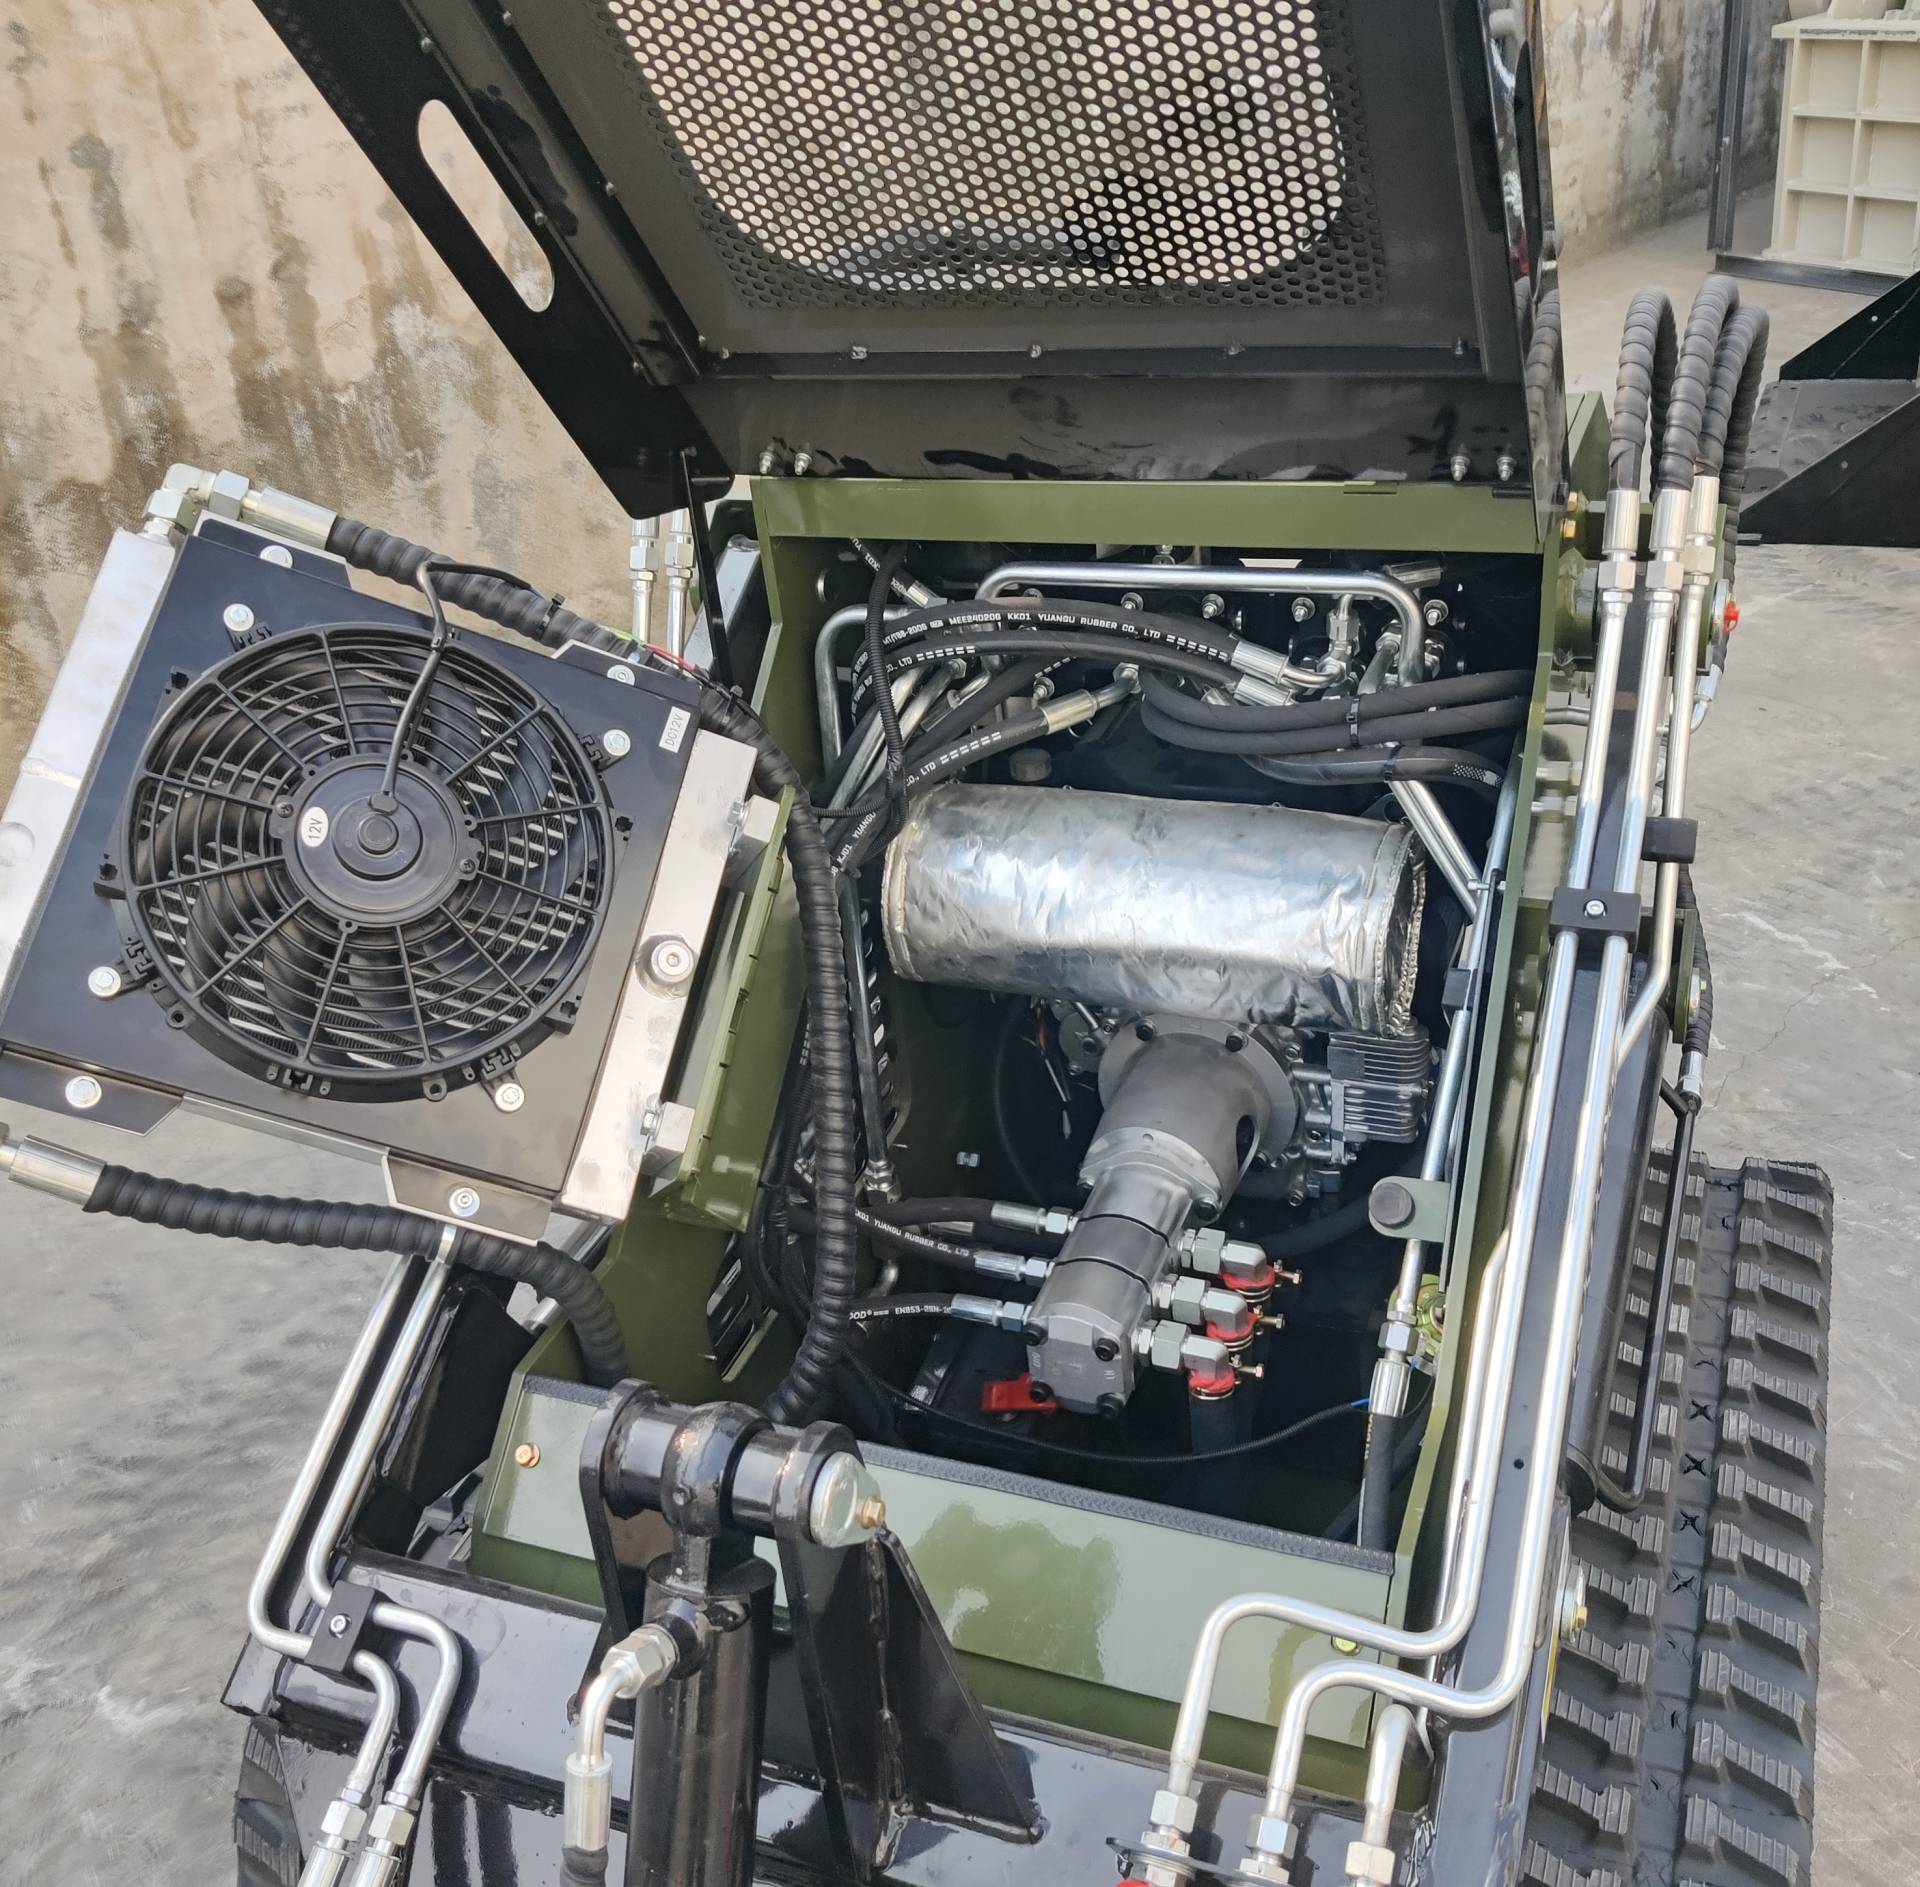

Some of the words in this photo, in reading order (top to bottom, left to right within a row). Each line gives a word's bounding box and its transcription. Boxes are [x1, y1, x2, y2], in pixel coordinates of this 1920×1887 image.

[1080, 617, 1118, 630] RUBBER
[1143, 628, 1161, 639] LTD
[898, 656, 913, 667] LTD
[665, 712, 684, 746] DC12V
[920, 761, 936, 776] LTD
[308, 817, 322, 839] 12V
[904, 1232, 934, 1248] RUBBER
[955, 1248, 970, 1257] LTD
